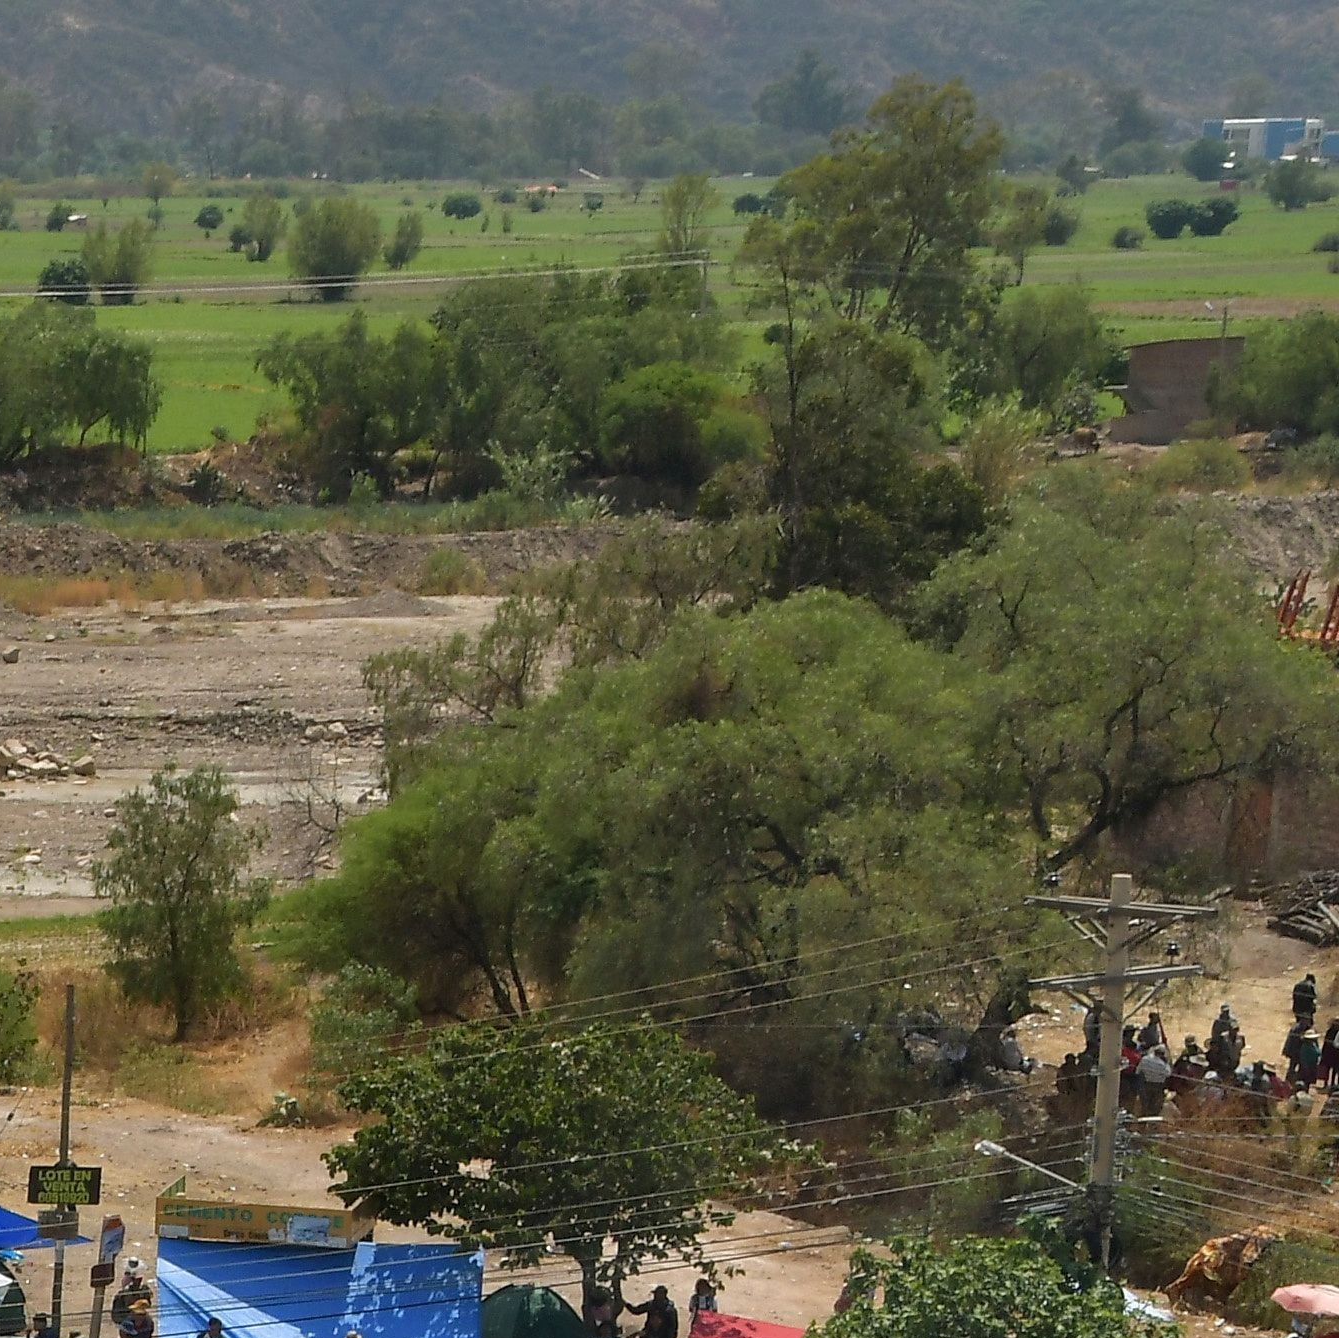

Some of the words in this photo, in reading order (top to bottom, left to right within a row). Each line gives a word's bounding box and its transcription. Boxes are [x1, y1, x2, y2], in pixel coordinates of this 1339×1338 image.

[38, 1170, 71, 1181] LOTE
[74, 1170, 91, 1181] EN
[43, 1181, 86, 1192] VENTA
[164, 1204, 253, 1222] CEMENTO
[267, 1210, 344, 1229] COE
